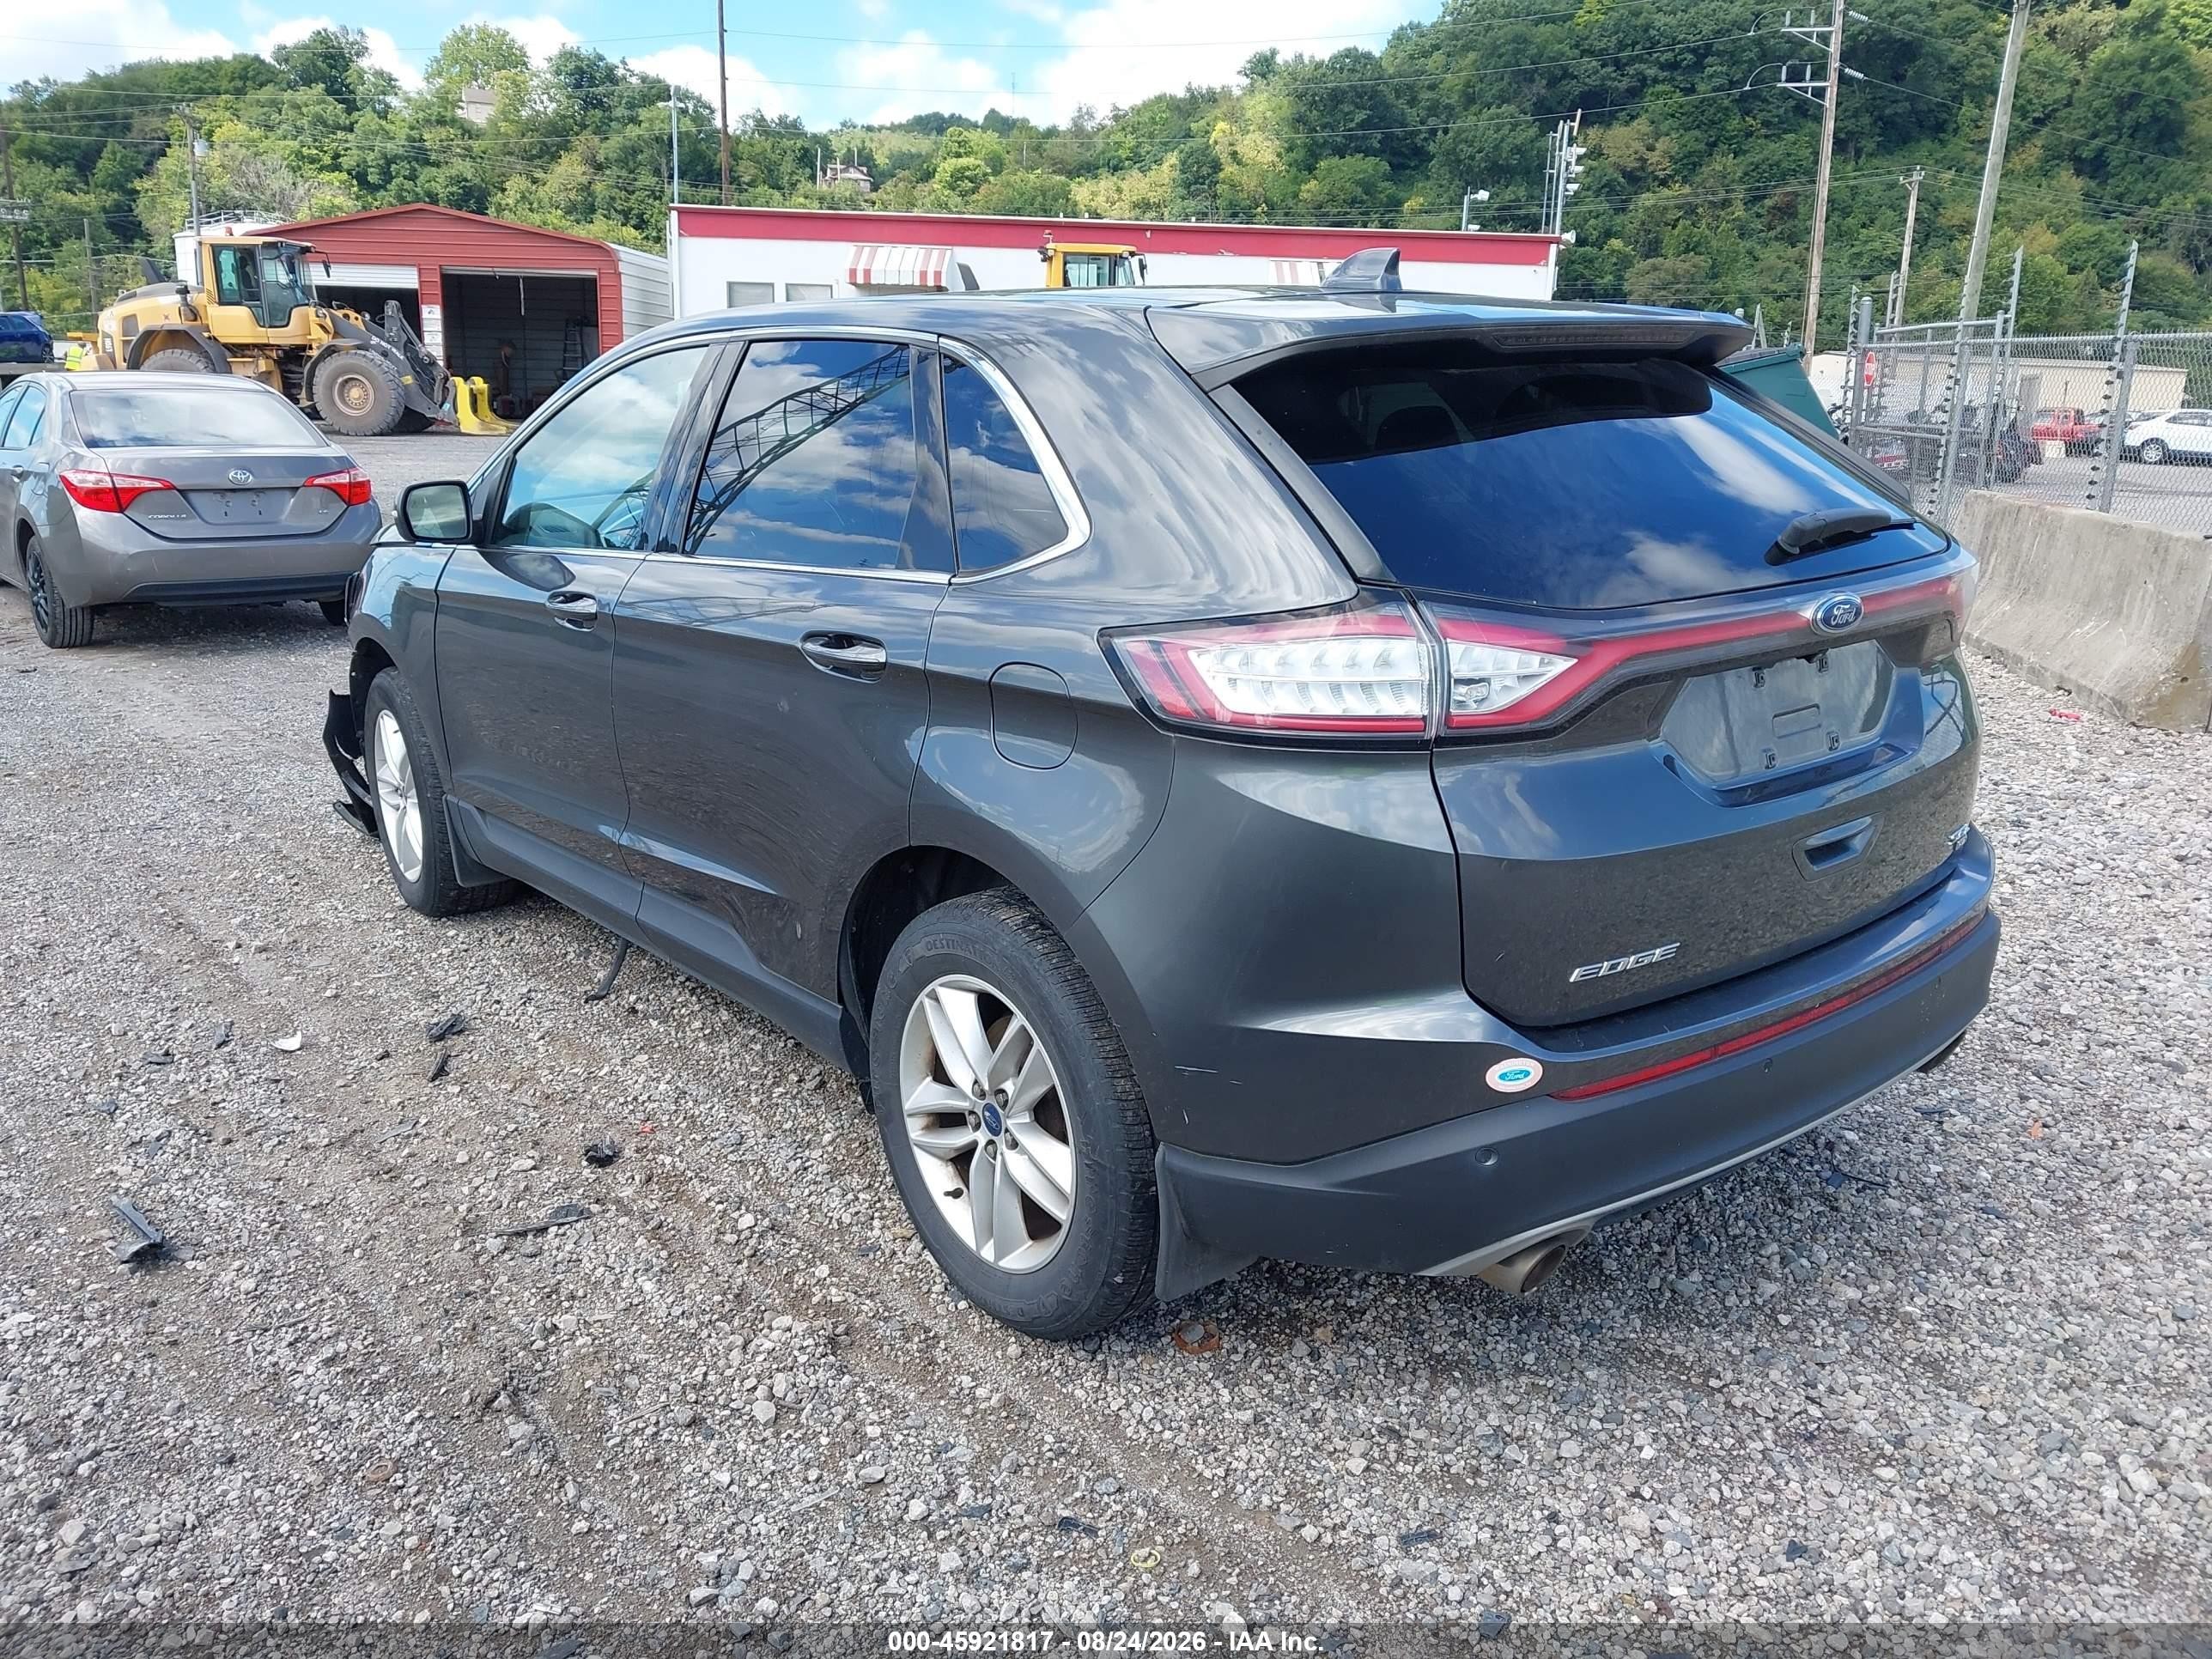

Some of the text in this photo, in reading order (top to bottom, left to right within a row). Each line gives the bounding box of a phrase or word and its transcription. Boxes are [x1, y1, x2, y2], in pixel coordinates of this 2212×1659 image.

[380, 340, 392, 349] NOT
[1831, 604, 1856, 626] Ford
[1568, 942, 1680, 982] EDGE
[1504, 1070, 1526, 1080] Ford
